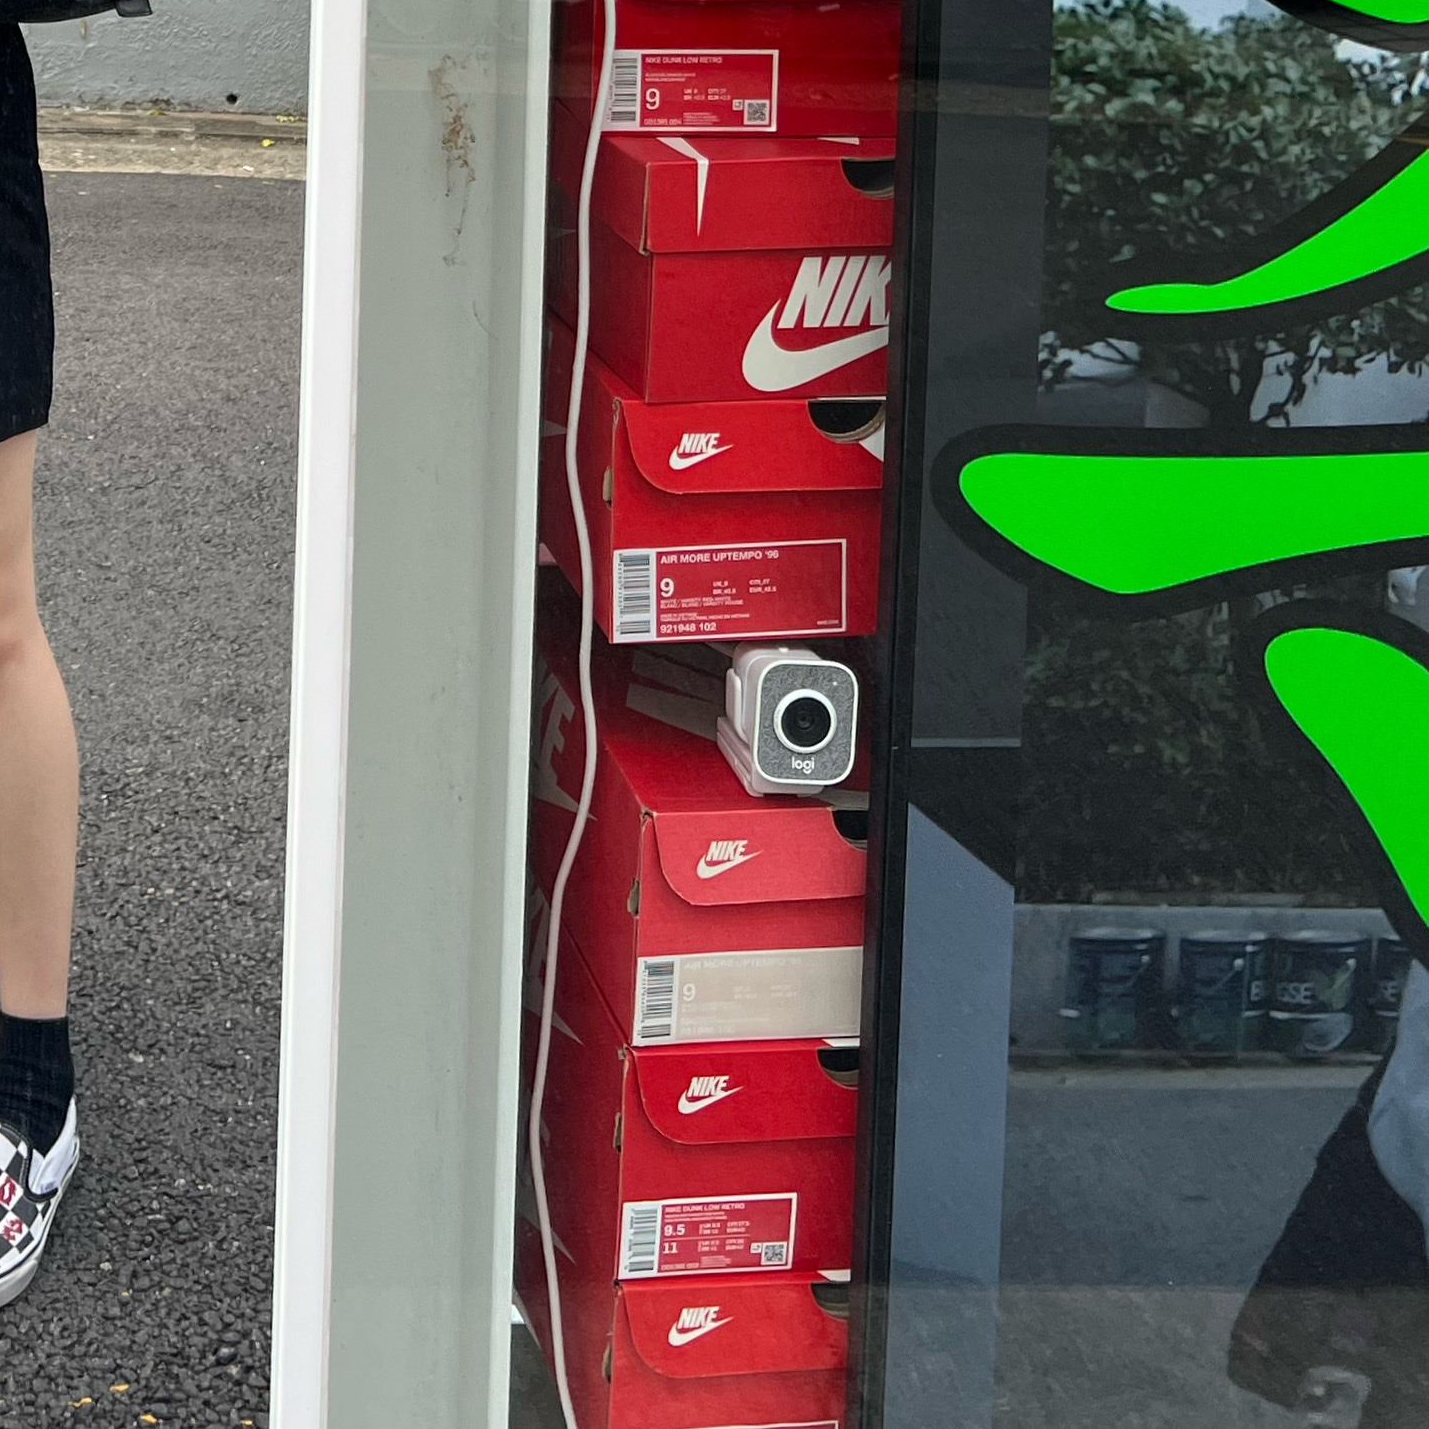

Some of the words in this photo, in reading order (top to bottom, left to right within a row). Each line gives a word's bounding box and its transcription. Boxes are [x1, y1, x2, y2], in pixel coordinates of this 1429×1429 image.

[645, 87, 660, 110] 9
[678, 433, 720, 454] NIKE
[660, 555, 678, 564] AIR
[680, 553, 711, 563] MORE
[712, 550, 763, 562] UPTEMPO
[660, 578, 674, 597] 9
[660, 623, 696, 634] 921948
[699, 622, 717, 632] 102
[791, 756, 815, 774] logi
[706, 840, 748, 861] NIKE
[682, 983, 696, 1002] 9
[687, 1076, 729, 1097] NIKE
[664, 1224, 686, 1236] 9.5
[662, 1242, 678, 1254] 11
[678, 1306, 719, 1329] NIKE
